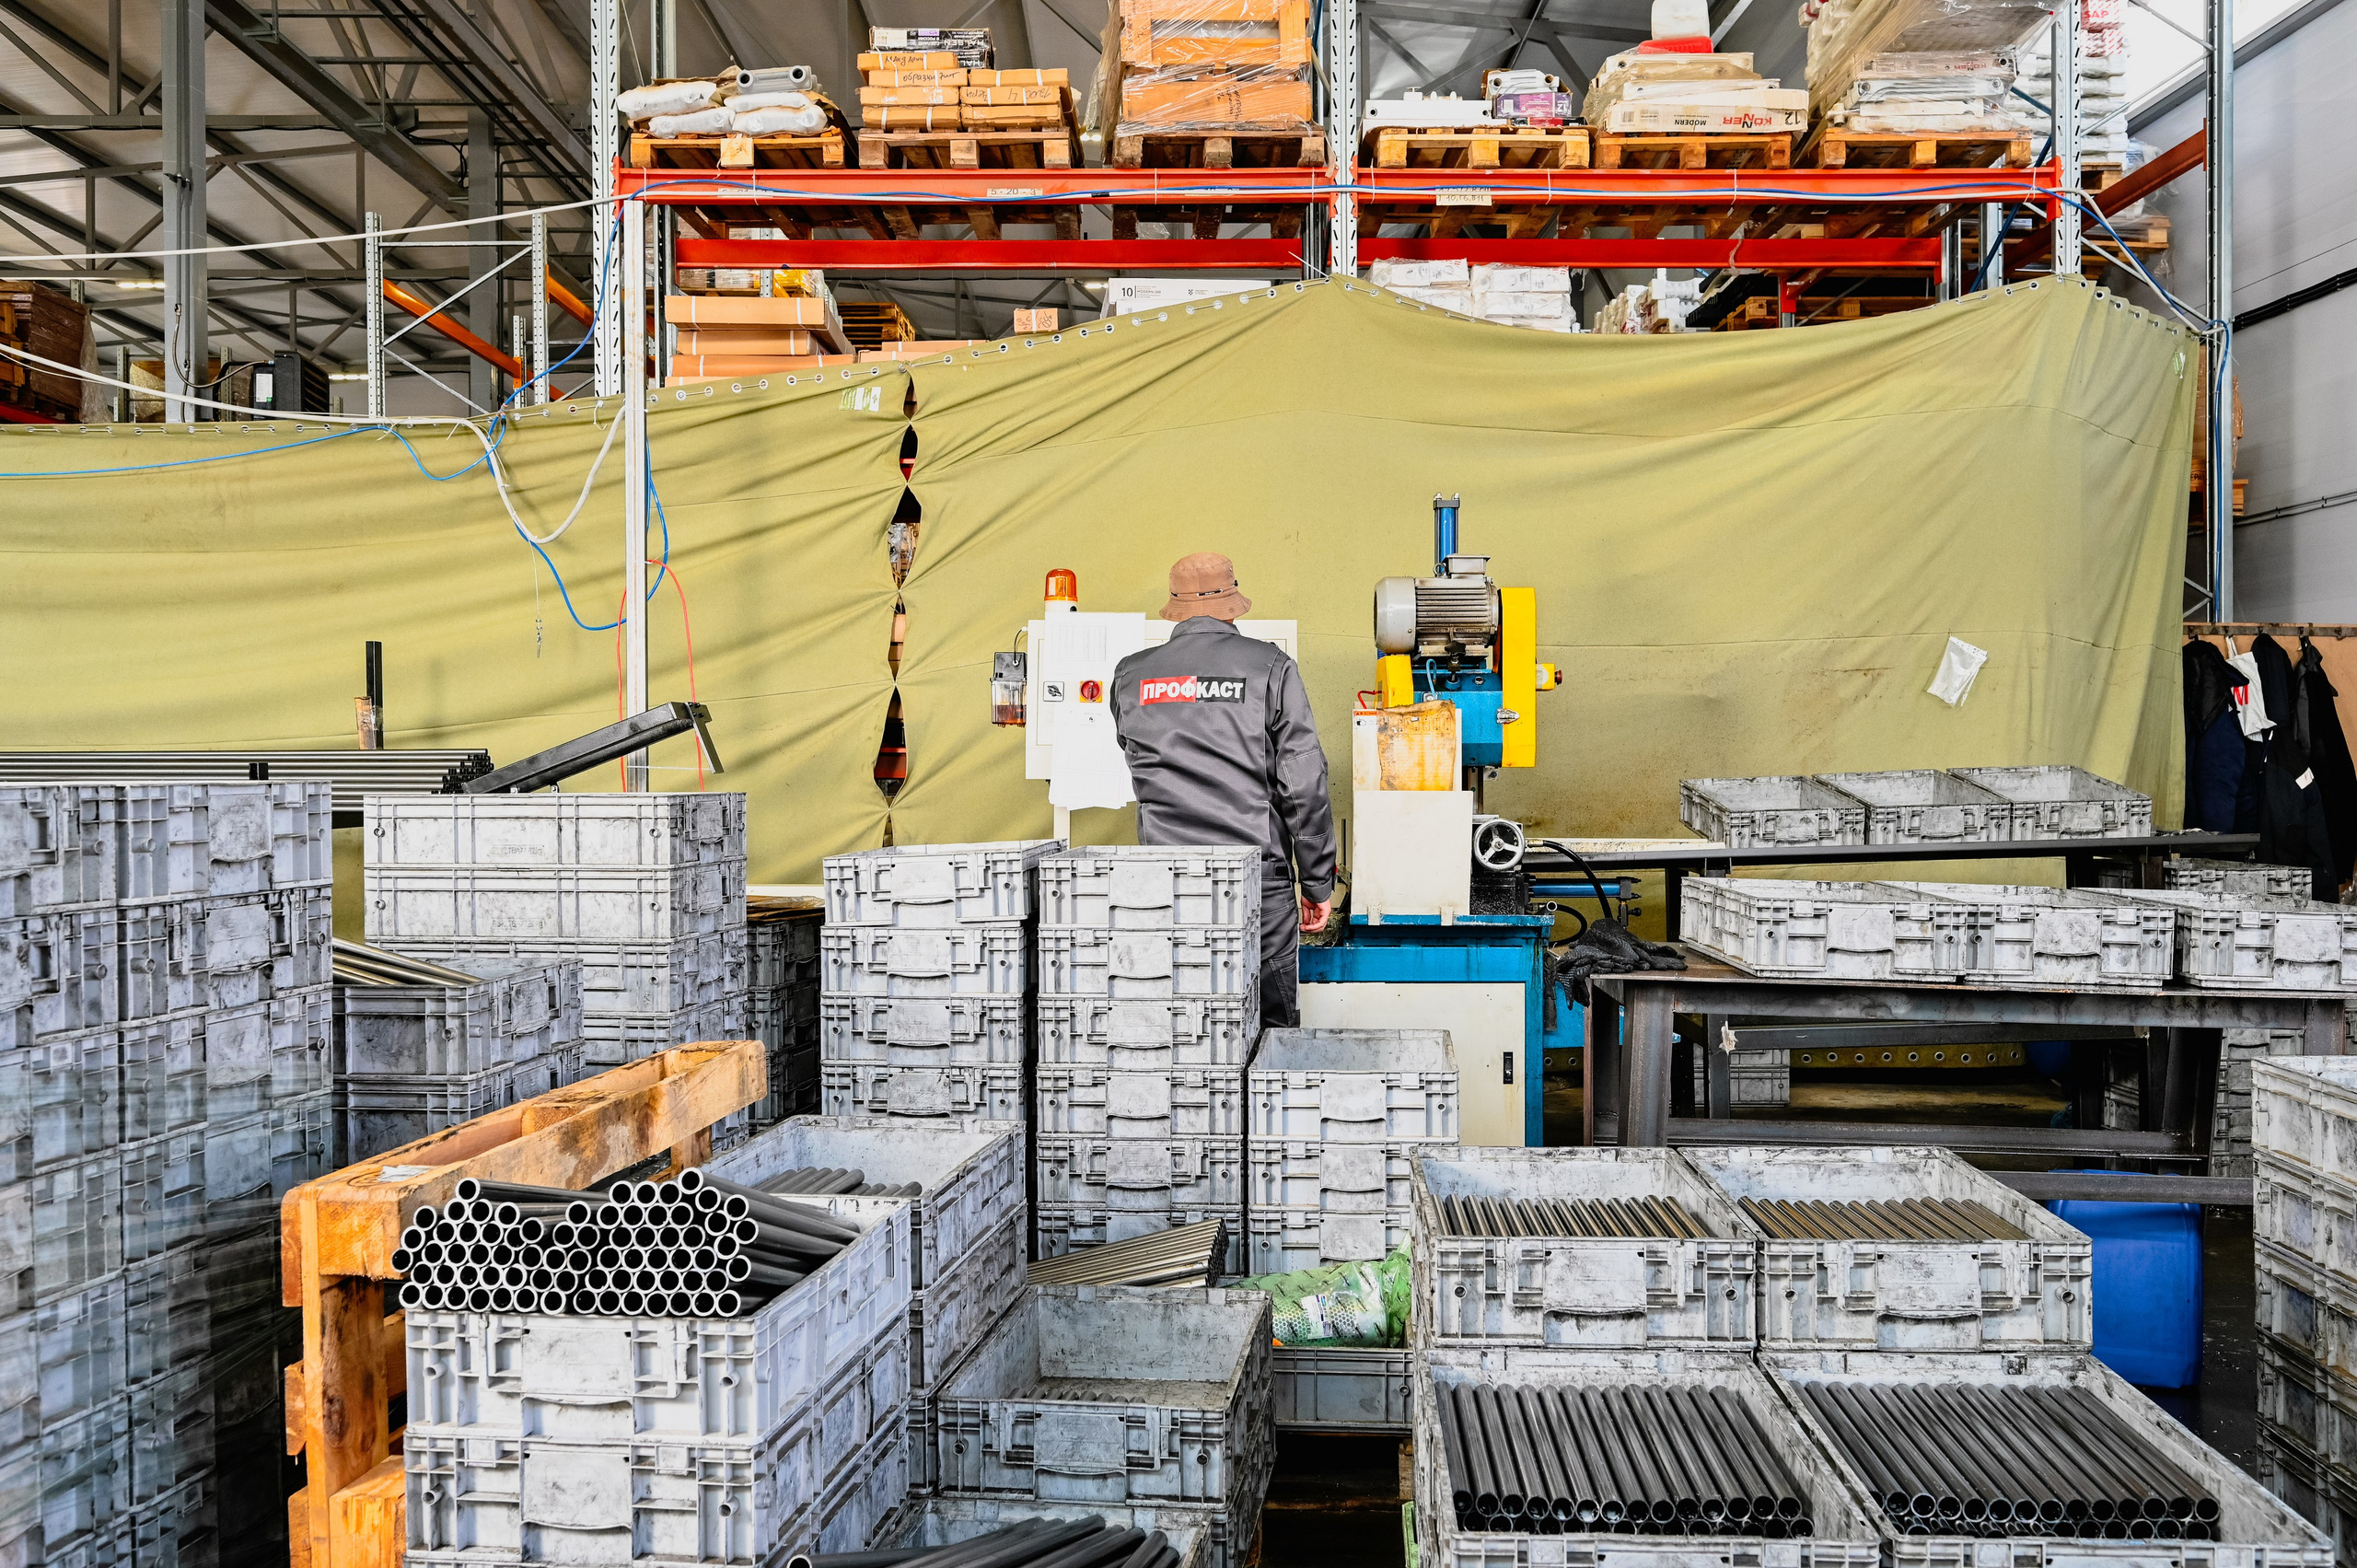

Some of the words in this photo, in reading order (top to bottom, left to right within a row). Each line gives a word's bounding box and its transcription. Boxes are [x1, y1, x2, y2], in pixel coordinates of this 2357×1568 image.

[1784, 110, 1801, 125] 12
[1121, 287, 1133, 297] 10
[1144, 680, 1244, 700] ПРОФКАСТ
